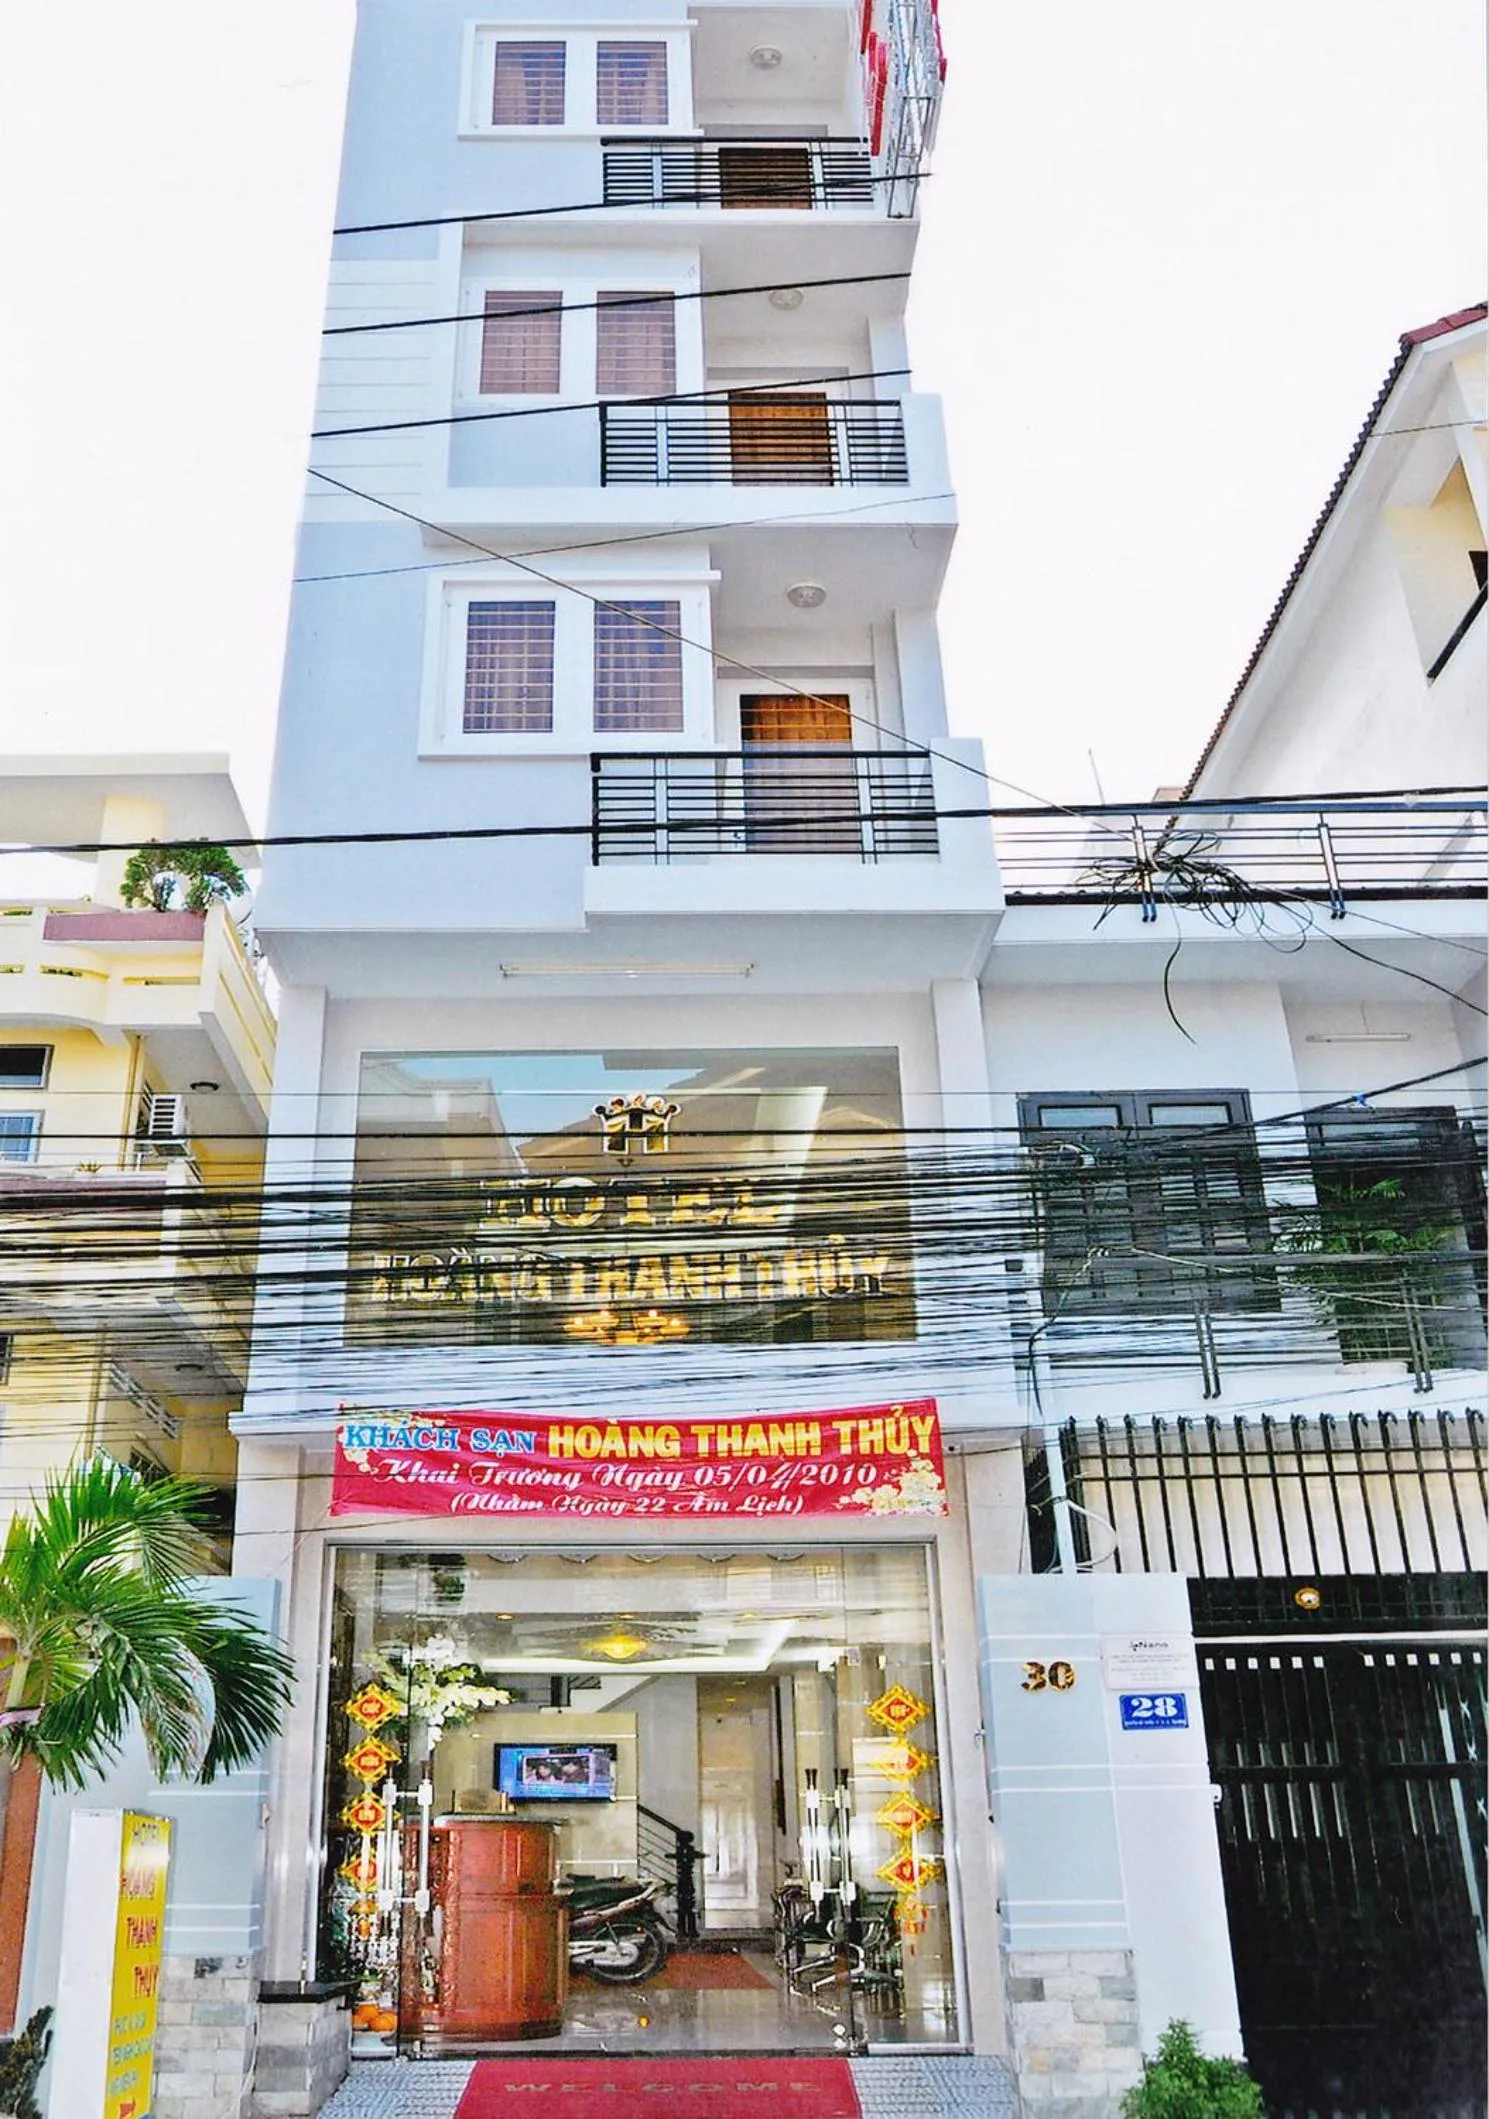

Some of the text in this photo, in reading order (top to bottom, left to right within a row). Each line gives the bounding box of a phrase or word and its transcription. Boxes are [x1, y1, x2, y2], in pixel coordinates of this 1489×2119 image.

[479, 1177, 780, 1227] HOTEL
[343, 1405, 936, 1459] KHÁCH SẠN HOÀNG THANH THỦY
[373, 1457, 460, 1485] Khai
[591, 1461, 687, 1491] Ngày
[551, 1494, 632, 1517] Ngày
[633, 1496, 667, 1513] 22
[1021, 1660, 1076, 1692] 30
[1130, 1697, 1178, 1718] 28
[504, 2081, 823, 2094] WELCOME
